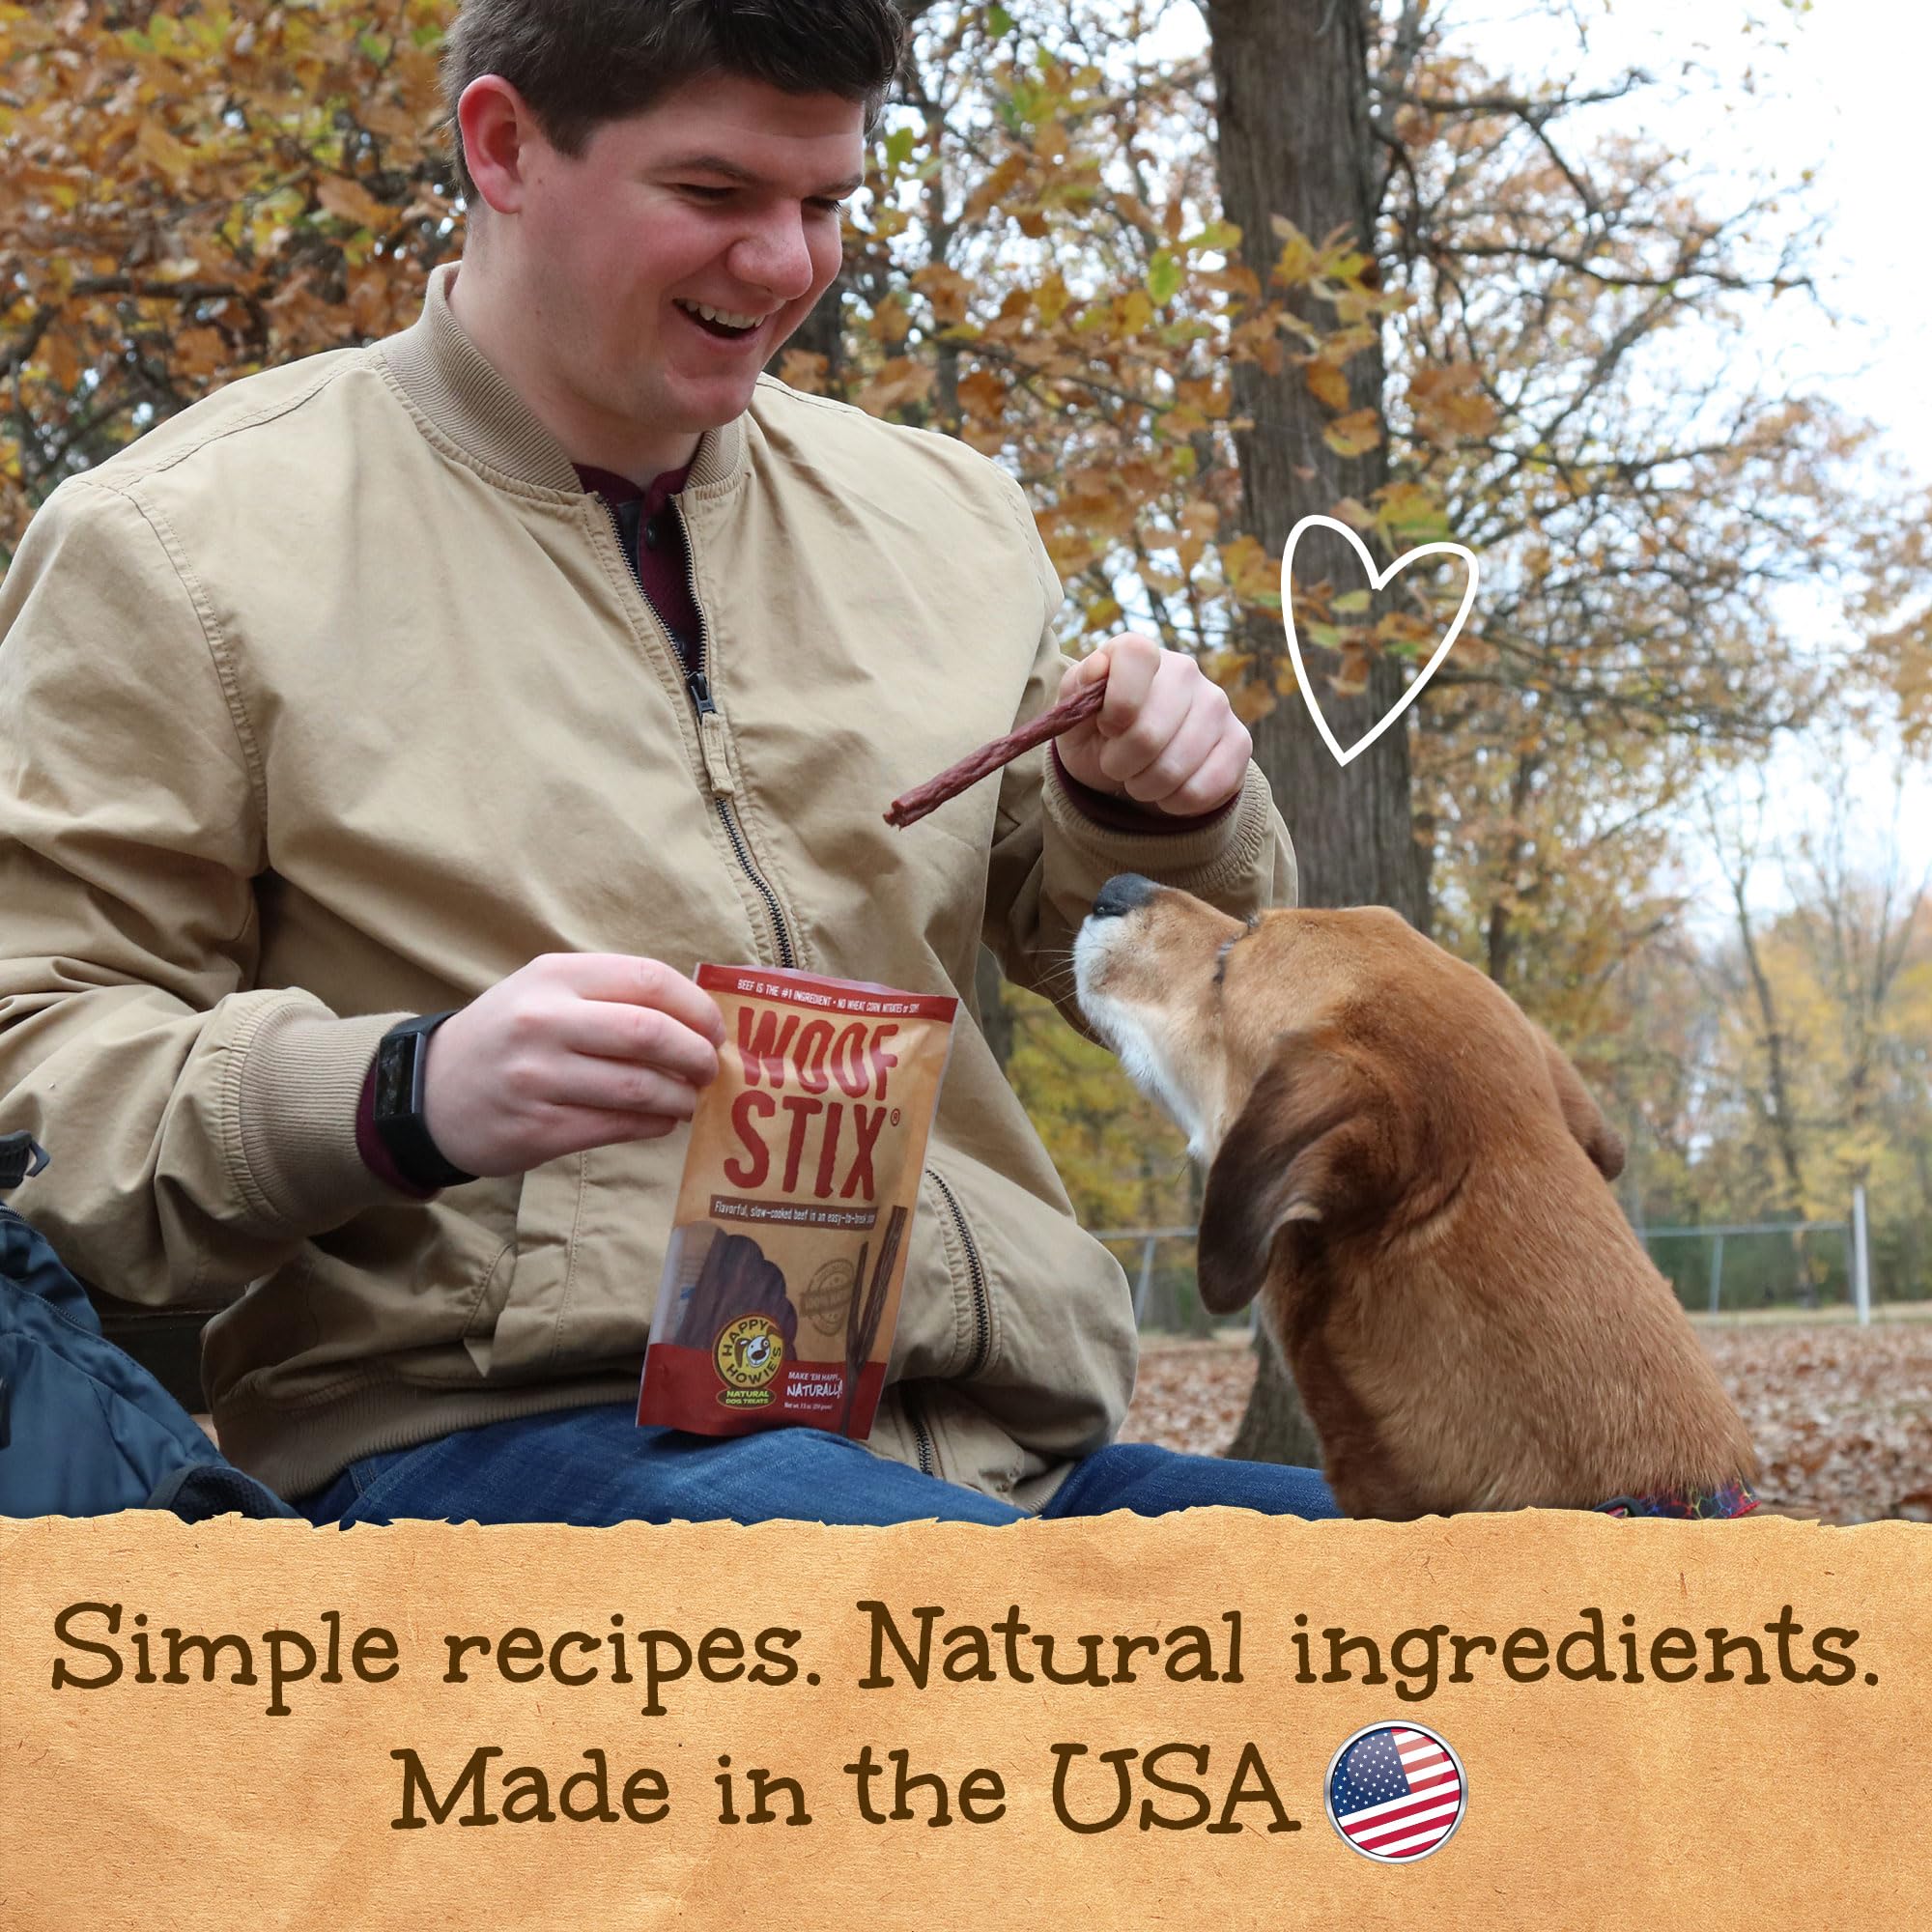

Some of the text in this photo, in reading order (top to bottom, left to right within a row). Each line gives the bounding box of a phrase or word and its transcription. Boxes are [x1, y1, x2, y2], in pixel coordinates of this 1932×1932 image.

[737, 979, 754, 991] BEEF
[755, 982, 764, 994] IS
[765, 983, 780, 997] THE
[781, 987, 792, 999] #1
[793, 990, 832, 1007] INGREDIENT
[837, 998, 846, 1009] NO
[847, 999, 866, 1012] WHEAT
[737, 1007, 899, 1101] WOOF
[724, 1090, 887, 1201] STIX
[715, 1200, 749, 1217] Flavorful,
[750, 1205, 792, 1220] slow-cooked
[793, 1208, 809, 1221] beef
[810, 1209, 816, 1222] in
[722, 1320, 768, 1357] HAPPY
[726, 1347, 781, 1384] HOWIE'S
[788, 1372, 810, 1380] MAKE
